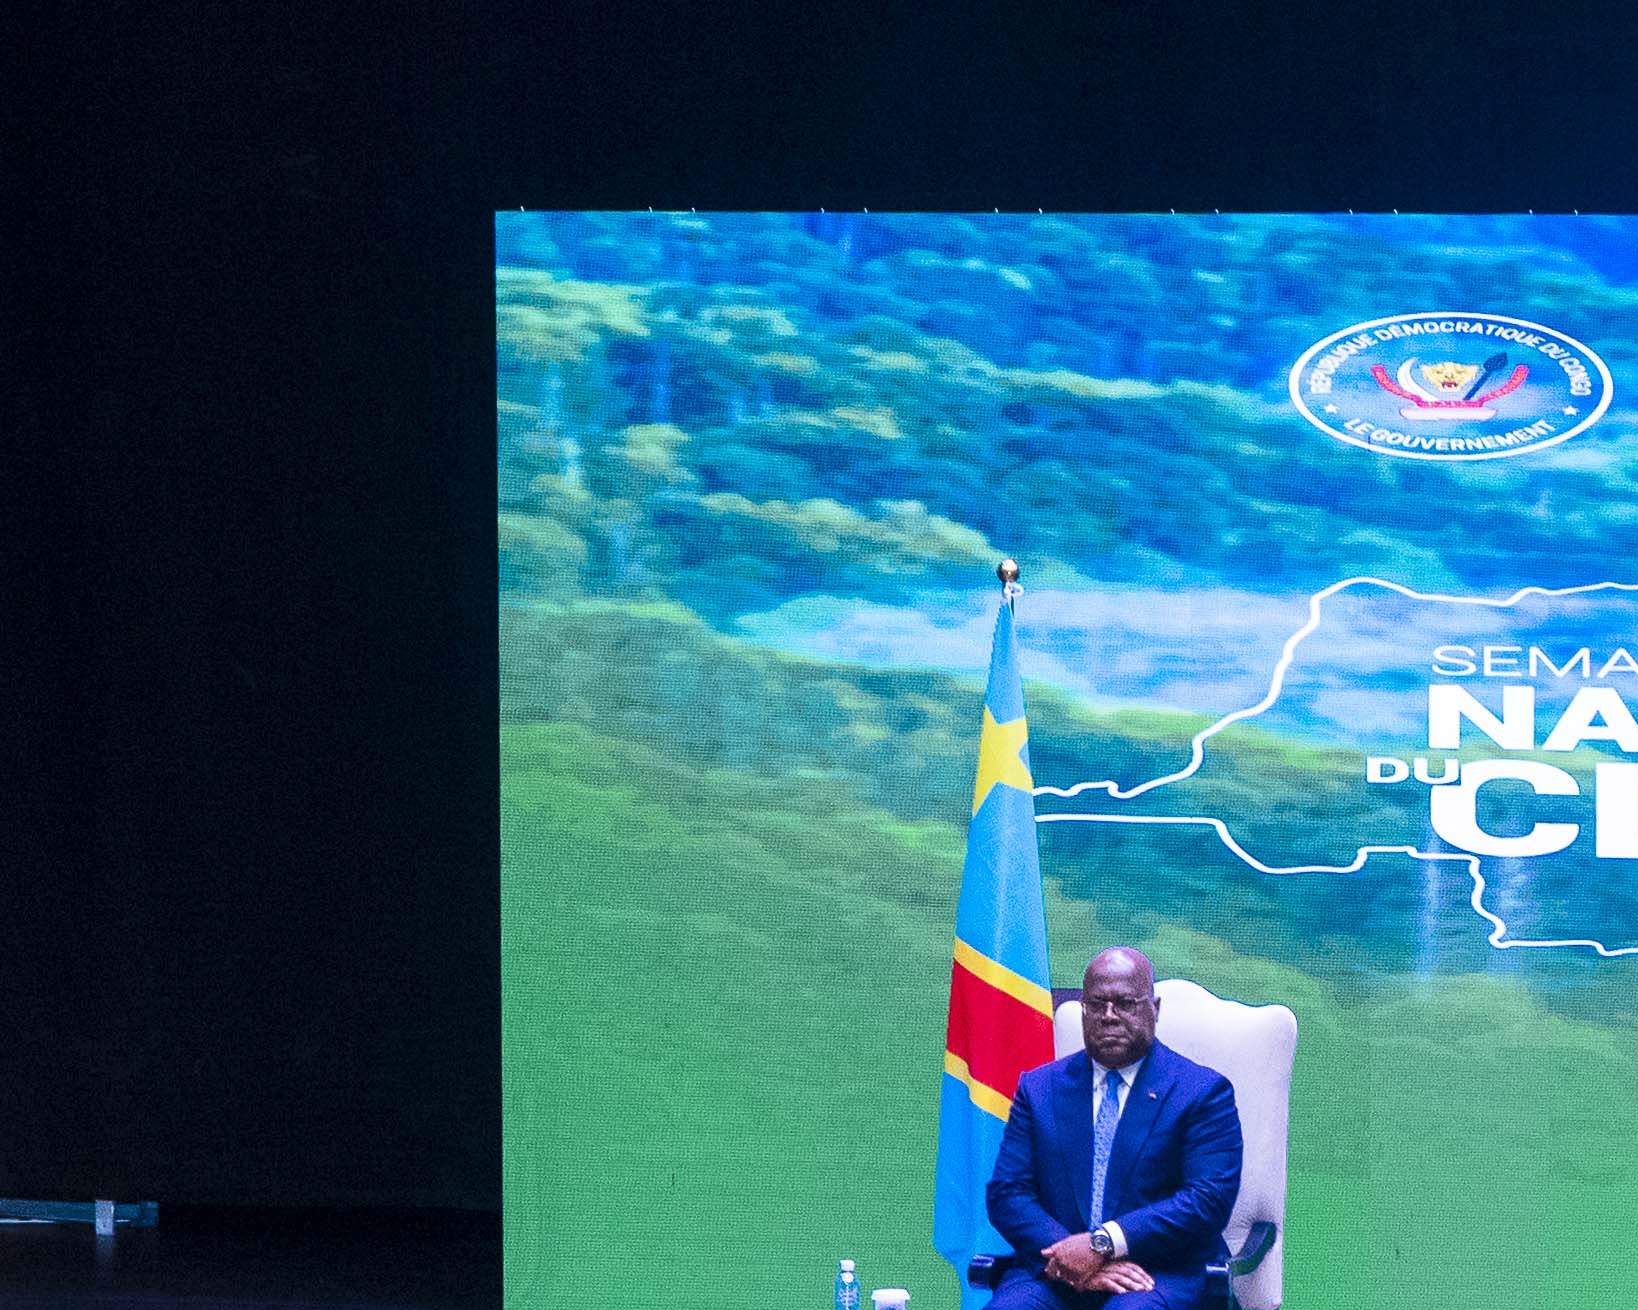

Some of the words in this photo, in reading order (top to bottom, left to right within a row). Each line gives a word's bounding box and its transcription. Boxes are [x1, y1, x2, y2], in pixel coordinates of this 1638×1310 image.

[1538, 341, 1566, 361] DU
[1558, 351, 1592, 397] CONGO
[1343, 418, 1373, 436] LE
[1370, 418, 1557, 452] GOUVERNEMENT
[1366, 757, 1461, 784] DU
